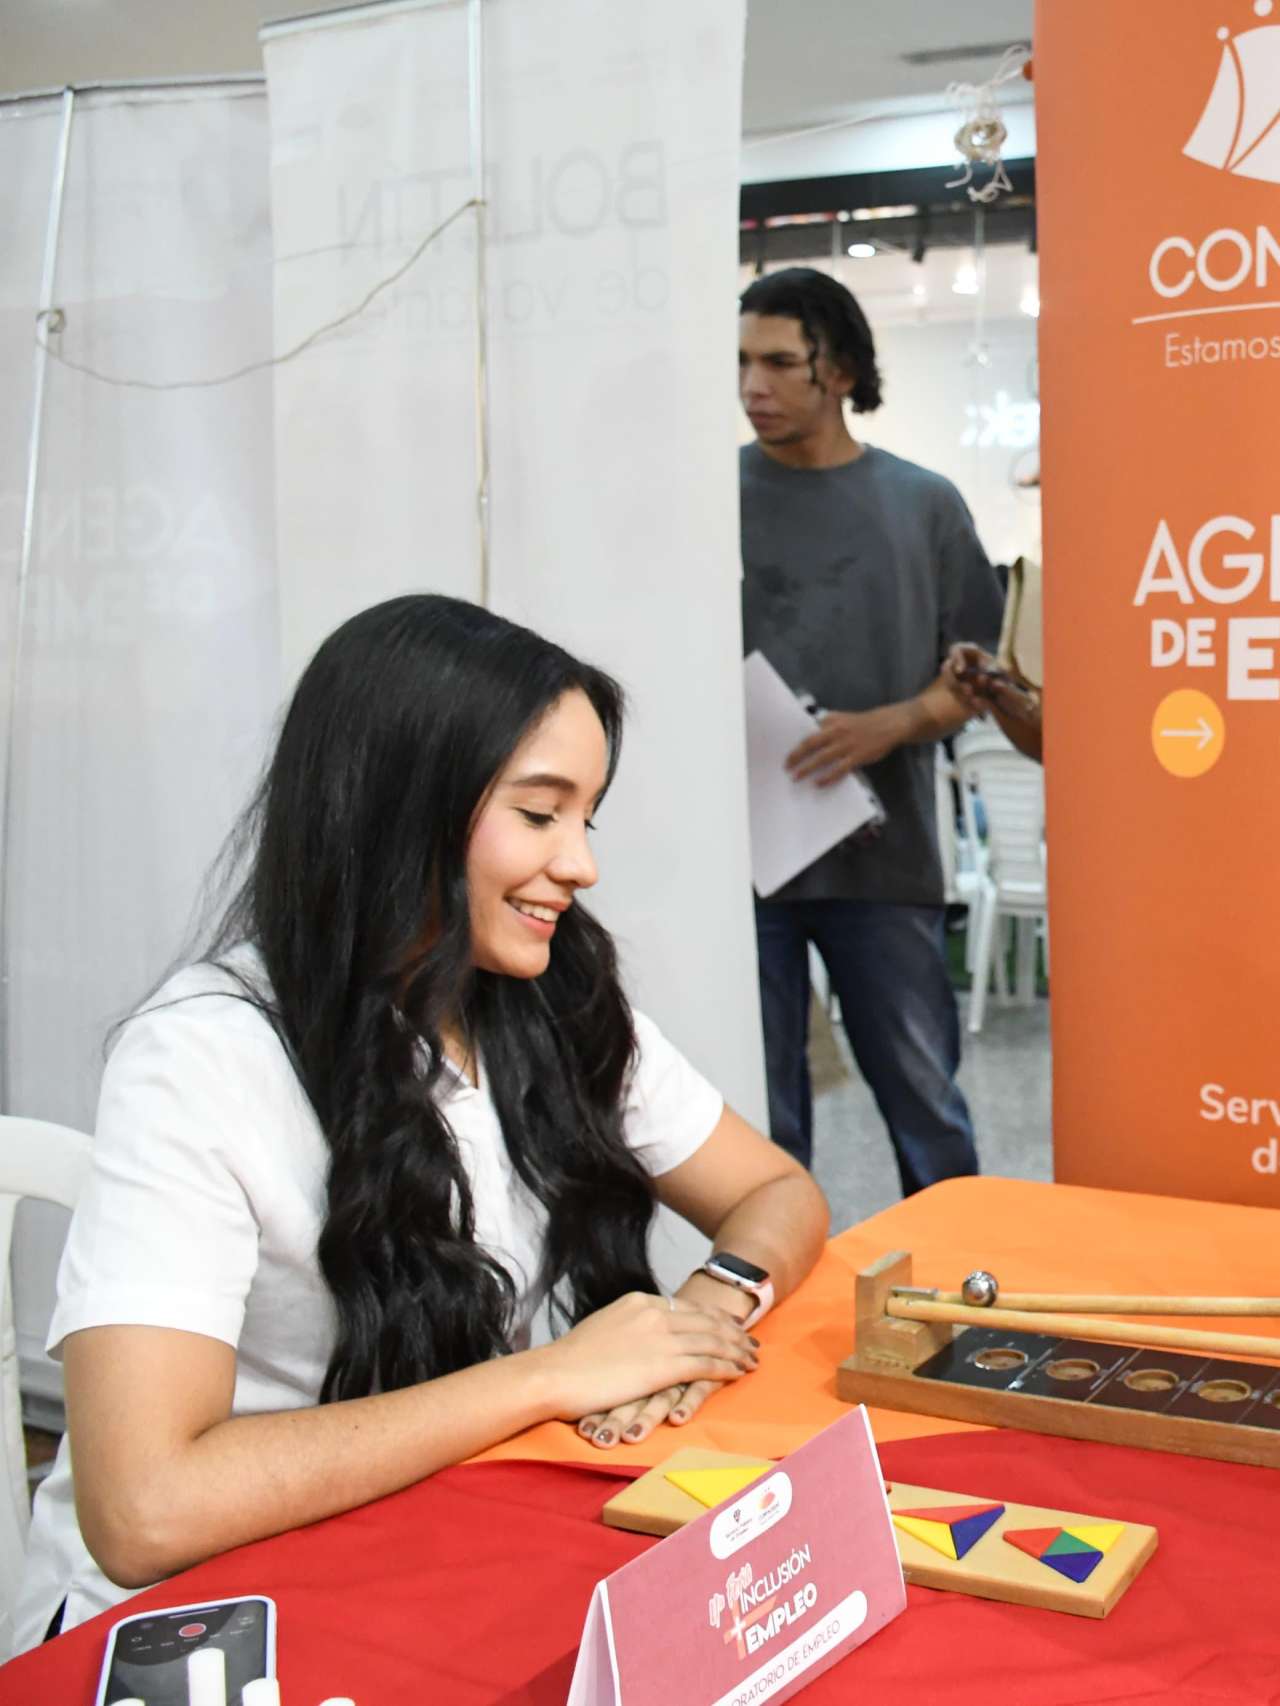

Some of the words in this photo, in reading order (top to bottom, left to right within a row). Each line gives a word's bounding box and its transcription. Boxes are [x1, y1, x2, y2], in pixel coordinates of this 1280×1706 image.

[1150, 618, 1215, 667] DE
[740, 1545, 811, 1614] INCLUSIÓN
[746, 1584, 817, 1654] EMPLEO
[787, 1653, 801, 1672] DE
[803, 1621, 840, 1659] EMPLEO
